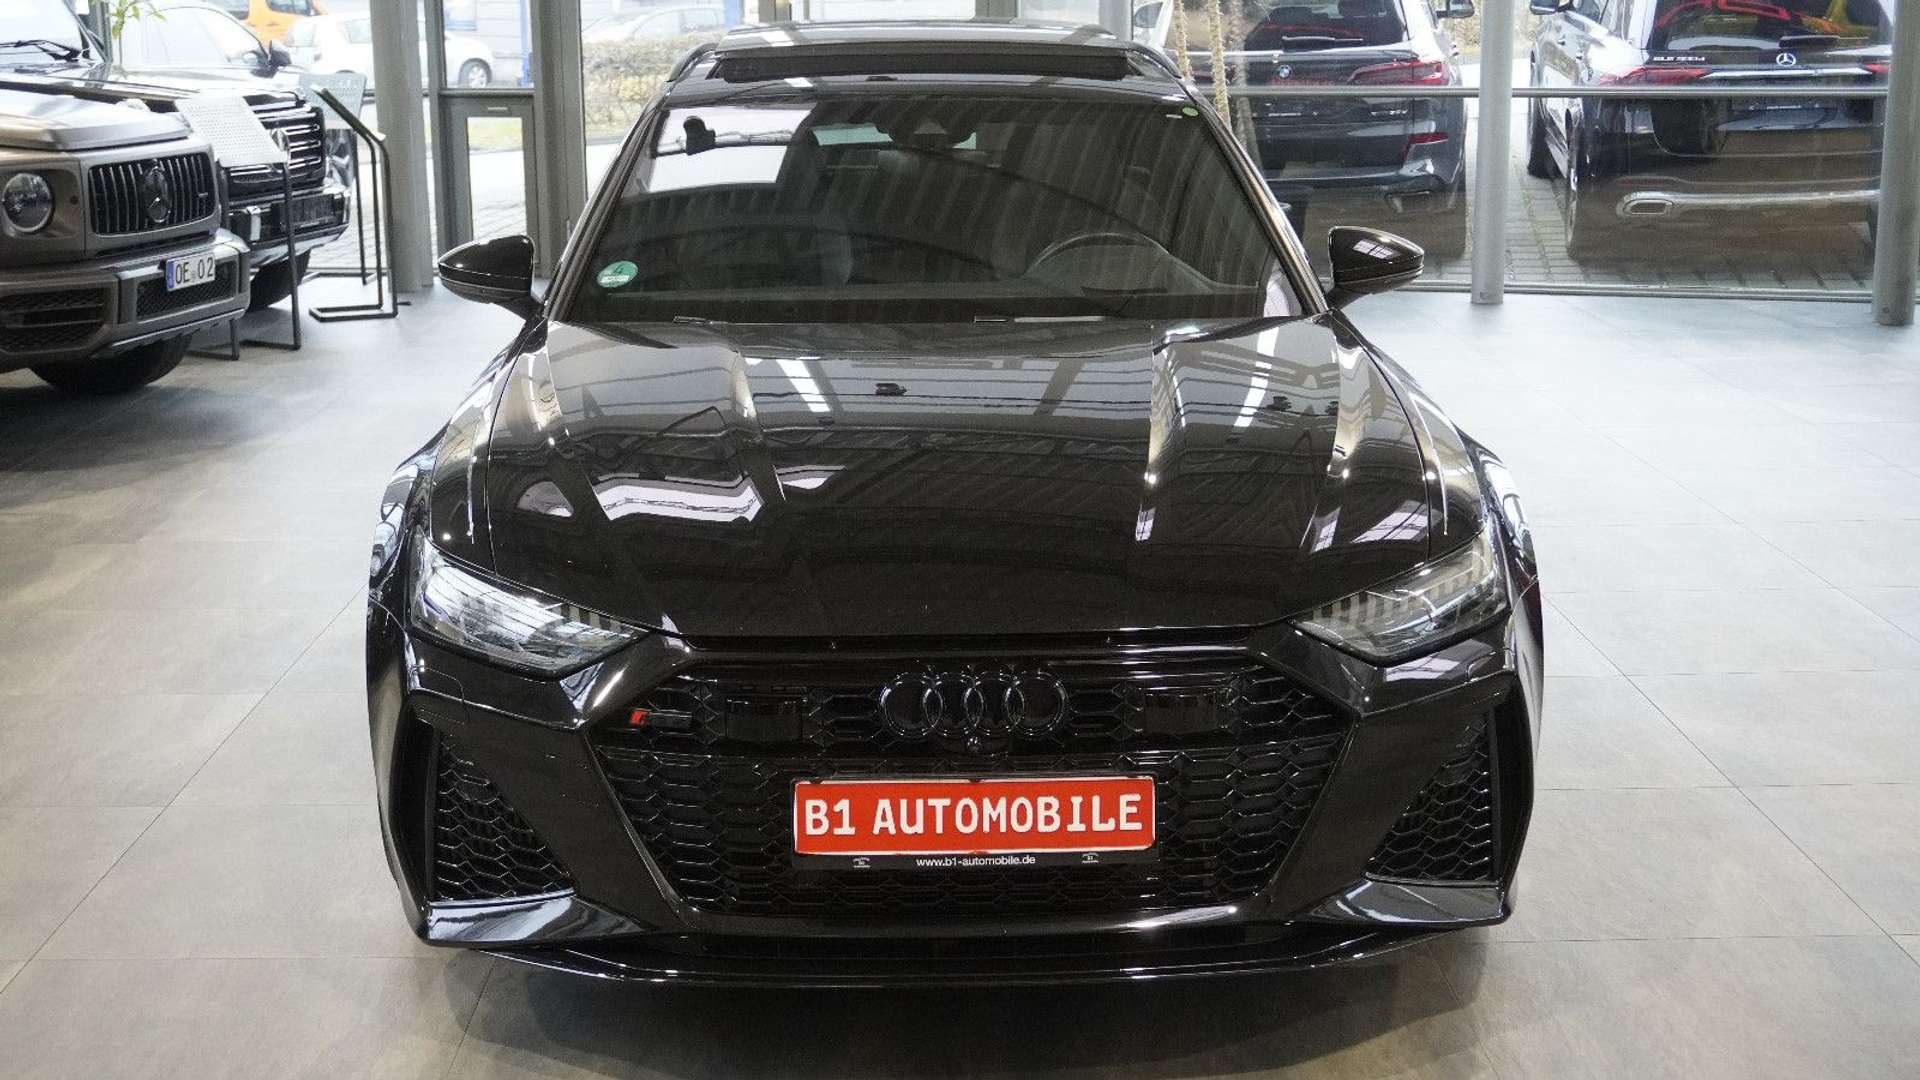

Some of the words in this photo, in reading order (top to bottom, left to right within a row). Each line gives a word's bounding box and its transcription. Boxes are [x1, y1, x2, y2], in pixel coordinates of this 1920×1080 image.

[805, 798, 856, 836] B1
[872, 793, 1143, 834] AUTOMOBILE
[916, 855, 1036, 866] www.b1-automobile.de
